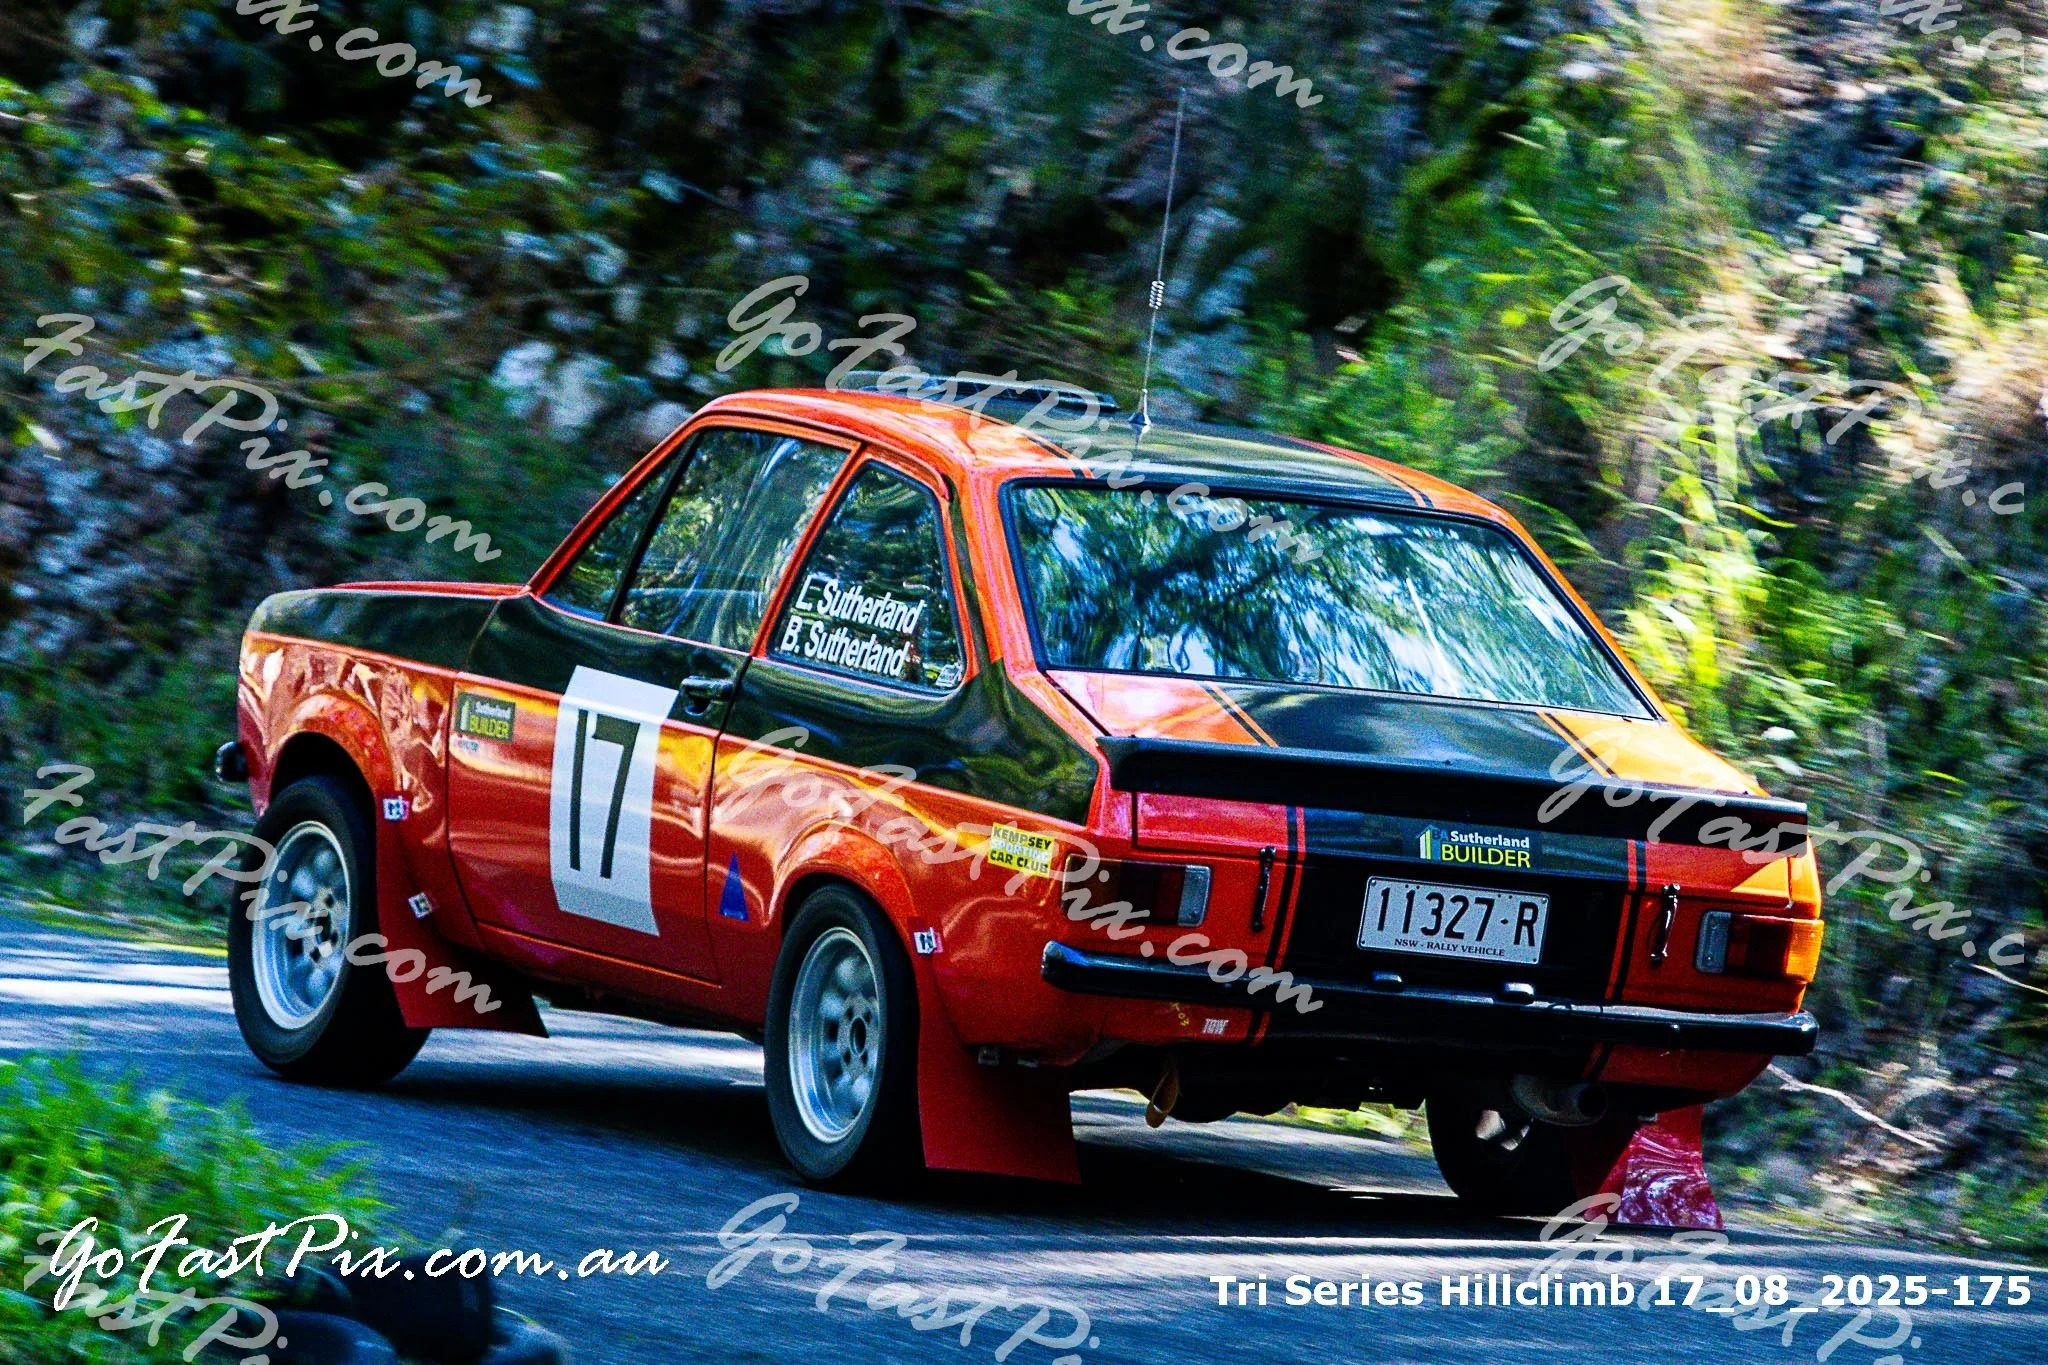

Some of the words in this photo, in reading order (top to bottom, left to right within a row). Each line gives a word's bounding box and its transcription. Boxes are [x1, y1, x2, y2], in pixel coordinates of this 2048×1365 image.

[817, 578, 925, 634] Sutherland
[781, 615, 802, 653] B.
[804, 621, 911, 677] Sutherland
[470, 714, 509, 739] BUILDER
[570, 708, 640, 879] 17
[993, 826, 1052, 850] KEMPSEY
[1450, 830, 1530, 849] Sutherland
[990, 850, 1013, 865] CAR
[1016, 856, 1049, 874] CLUB
[991, 838, 1049, 864] SPORTING
[1441, 843, 1531, 869] BUILDER
[1394, 938, 1419, 948] NSW
[1426, 941, 1459, 952] RALLY
[1461, 945, 1506, 957] VEHICLE
[1202, 1018, 1230, 1035] TOW
